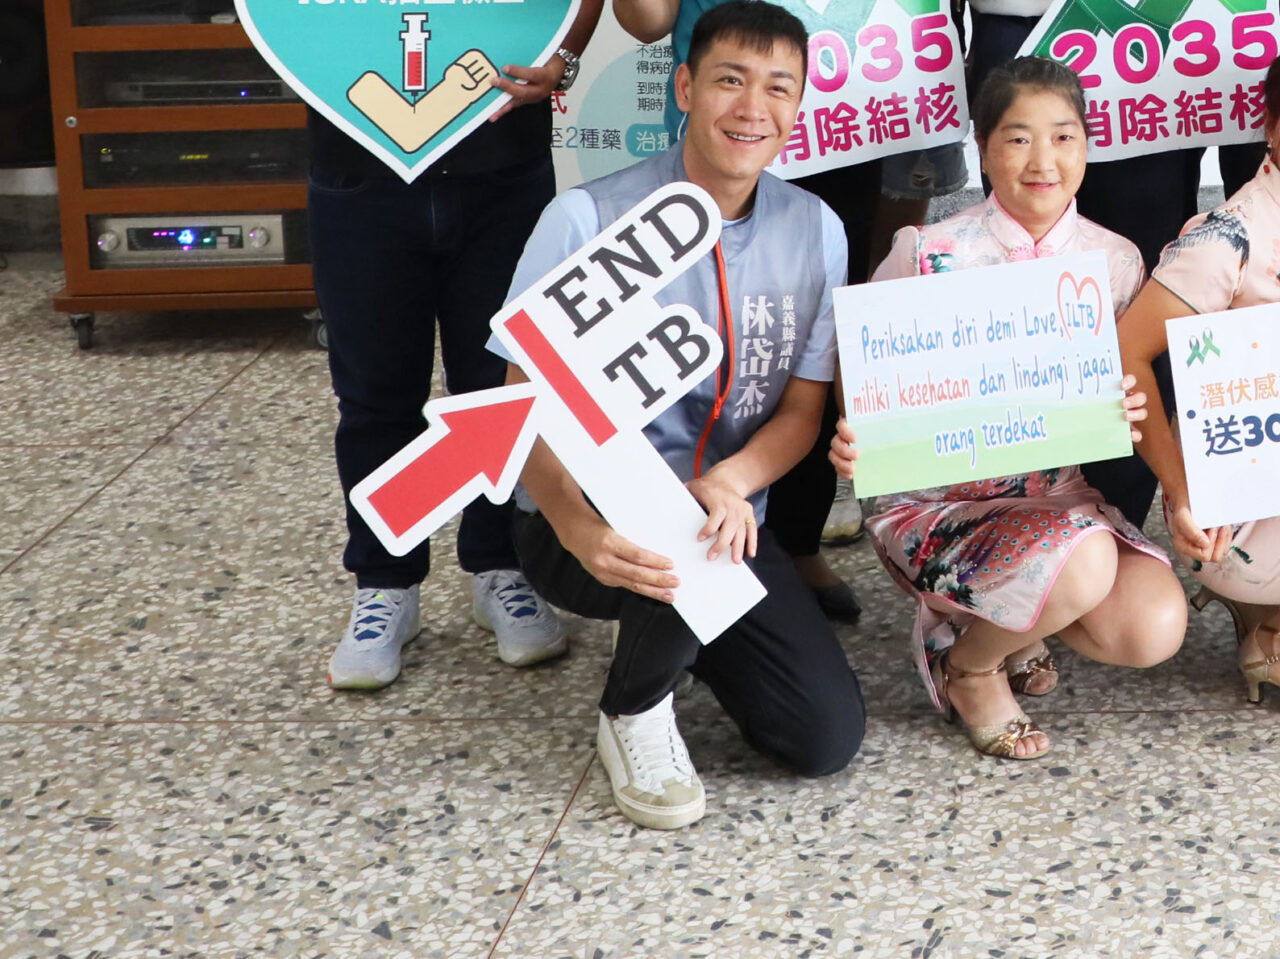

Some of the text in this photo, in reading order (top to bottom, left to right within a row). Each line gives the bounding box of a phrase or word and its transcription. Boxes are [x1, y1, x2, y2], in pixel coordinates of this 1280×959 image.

[808, 14, 953, 93] 035
[1052, 13, 1279, 90] 2035
[637, 81, 667, 95] 到時
[543, 193, 710, 338] END
[602, 314, 711, 410] TB
[861, 318, 944, 364] Periksakan
[952, 315, 978, 348] diri
[986, 310, 1017, 344] demi
[853, 375, 891, 416] miliki
[897, 370, 971, 409] kesehatan
[979, 363, 1006, 396] dan
[1012, 355, 1069, 400] lindungi
[935, 406, 1047, 468] orang terdekat
